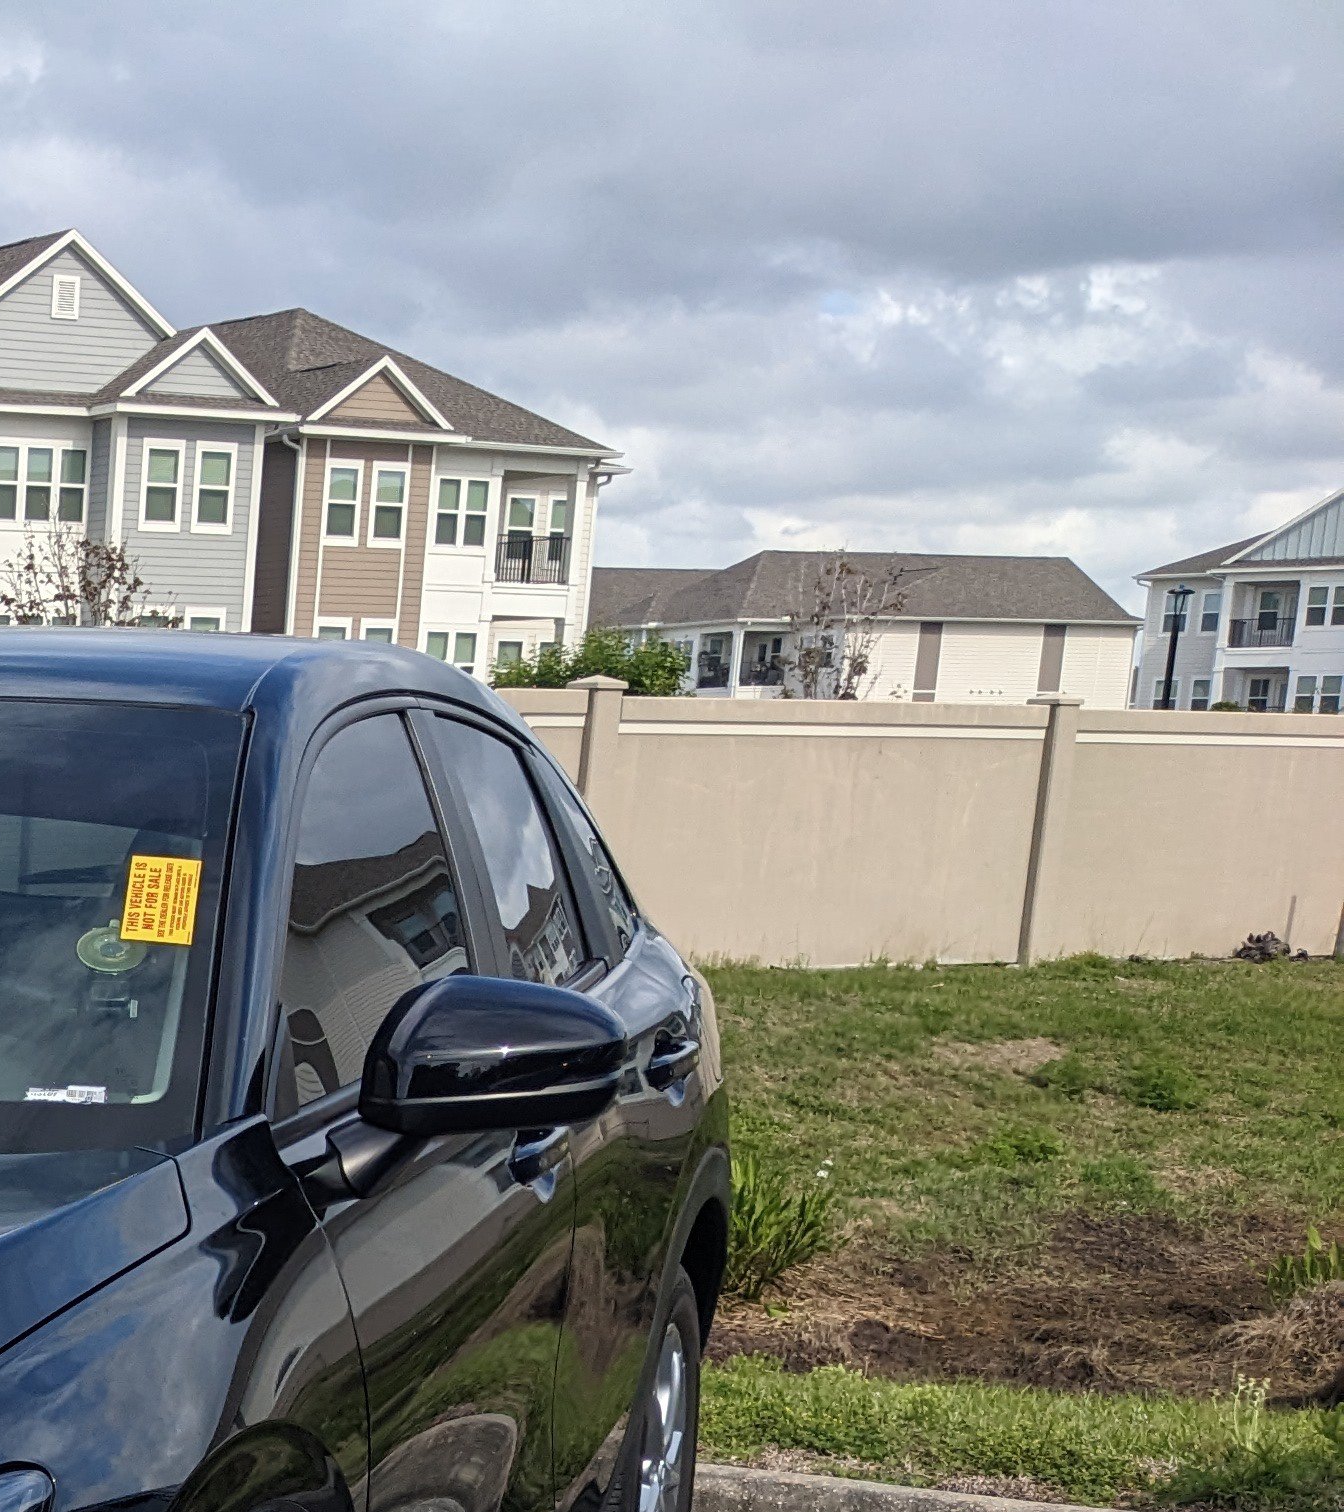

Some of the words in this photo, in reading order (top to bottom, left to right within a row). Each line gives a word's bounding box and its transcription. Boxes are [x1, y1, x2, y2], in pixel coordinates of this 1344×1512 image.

[135, 862, 147, 870] IS
[147, 867, 162, 889] SALE
[129, 873, 146, 909] VEHICLE
[145, 892, 158, 909] FOR
[126, 912, 140, 932] THIS
[142, 912, 155, 930] NOT
